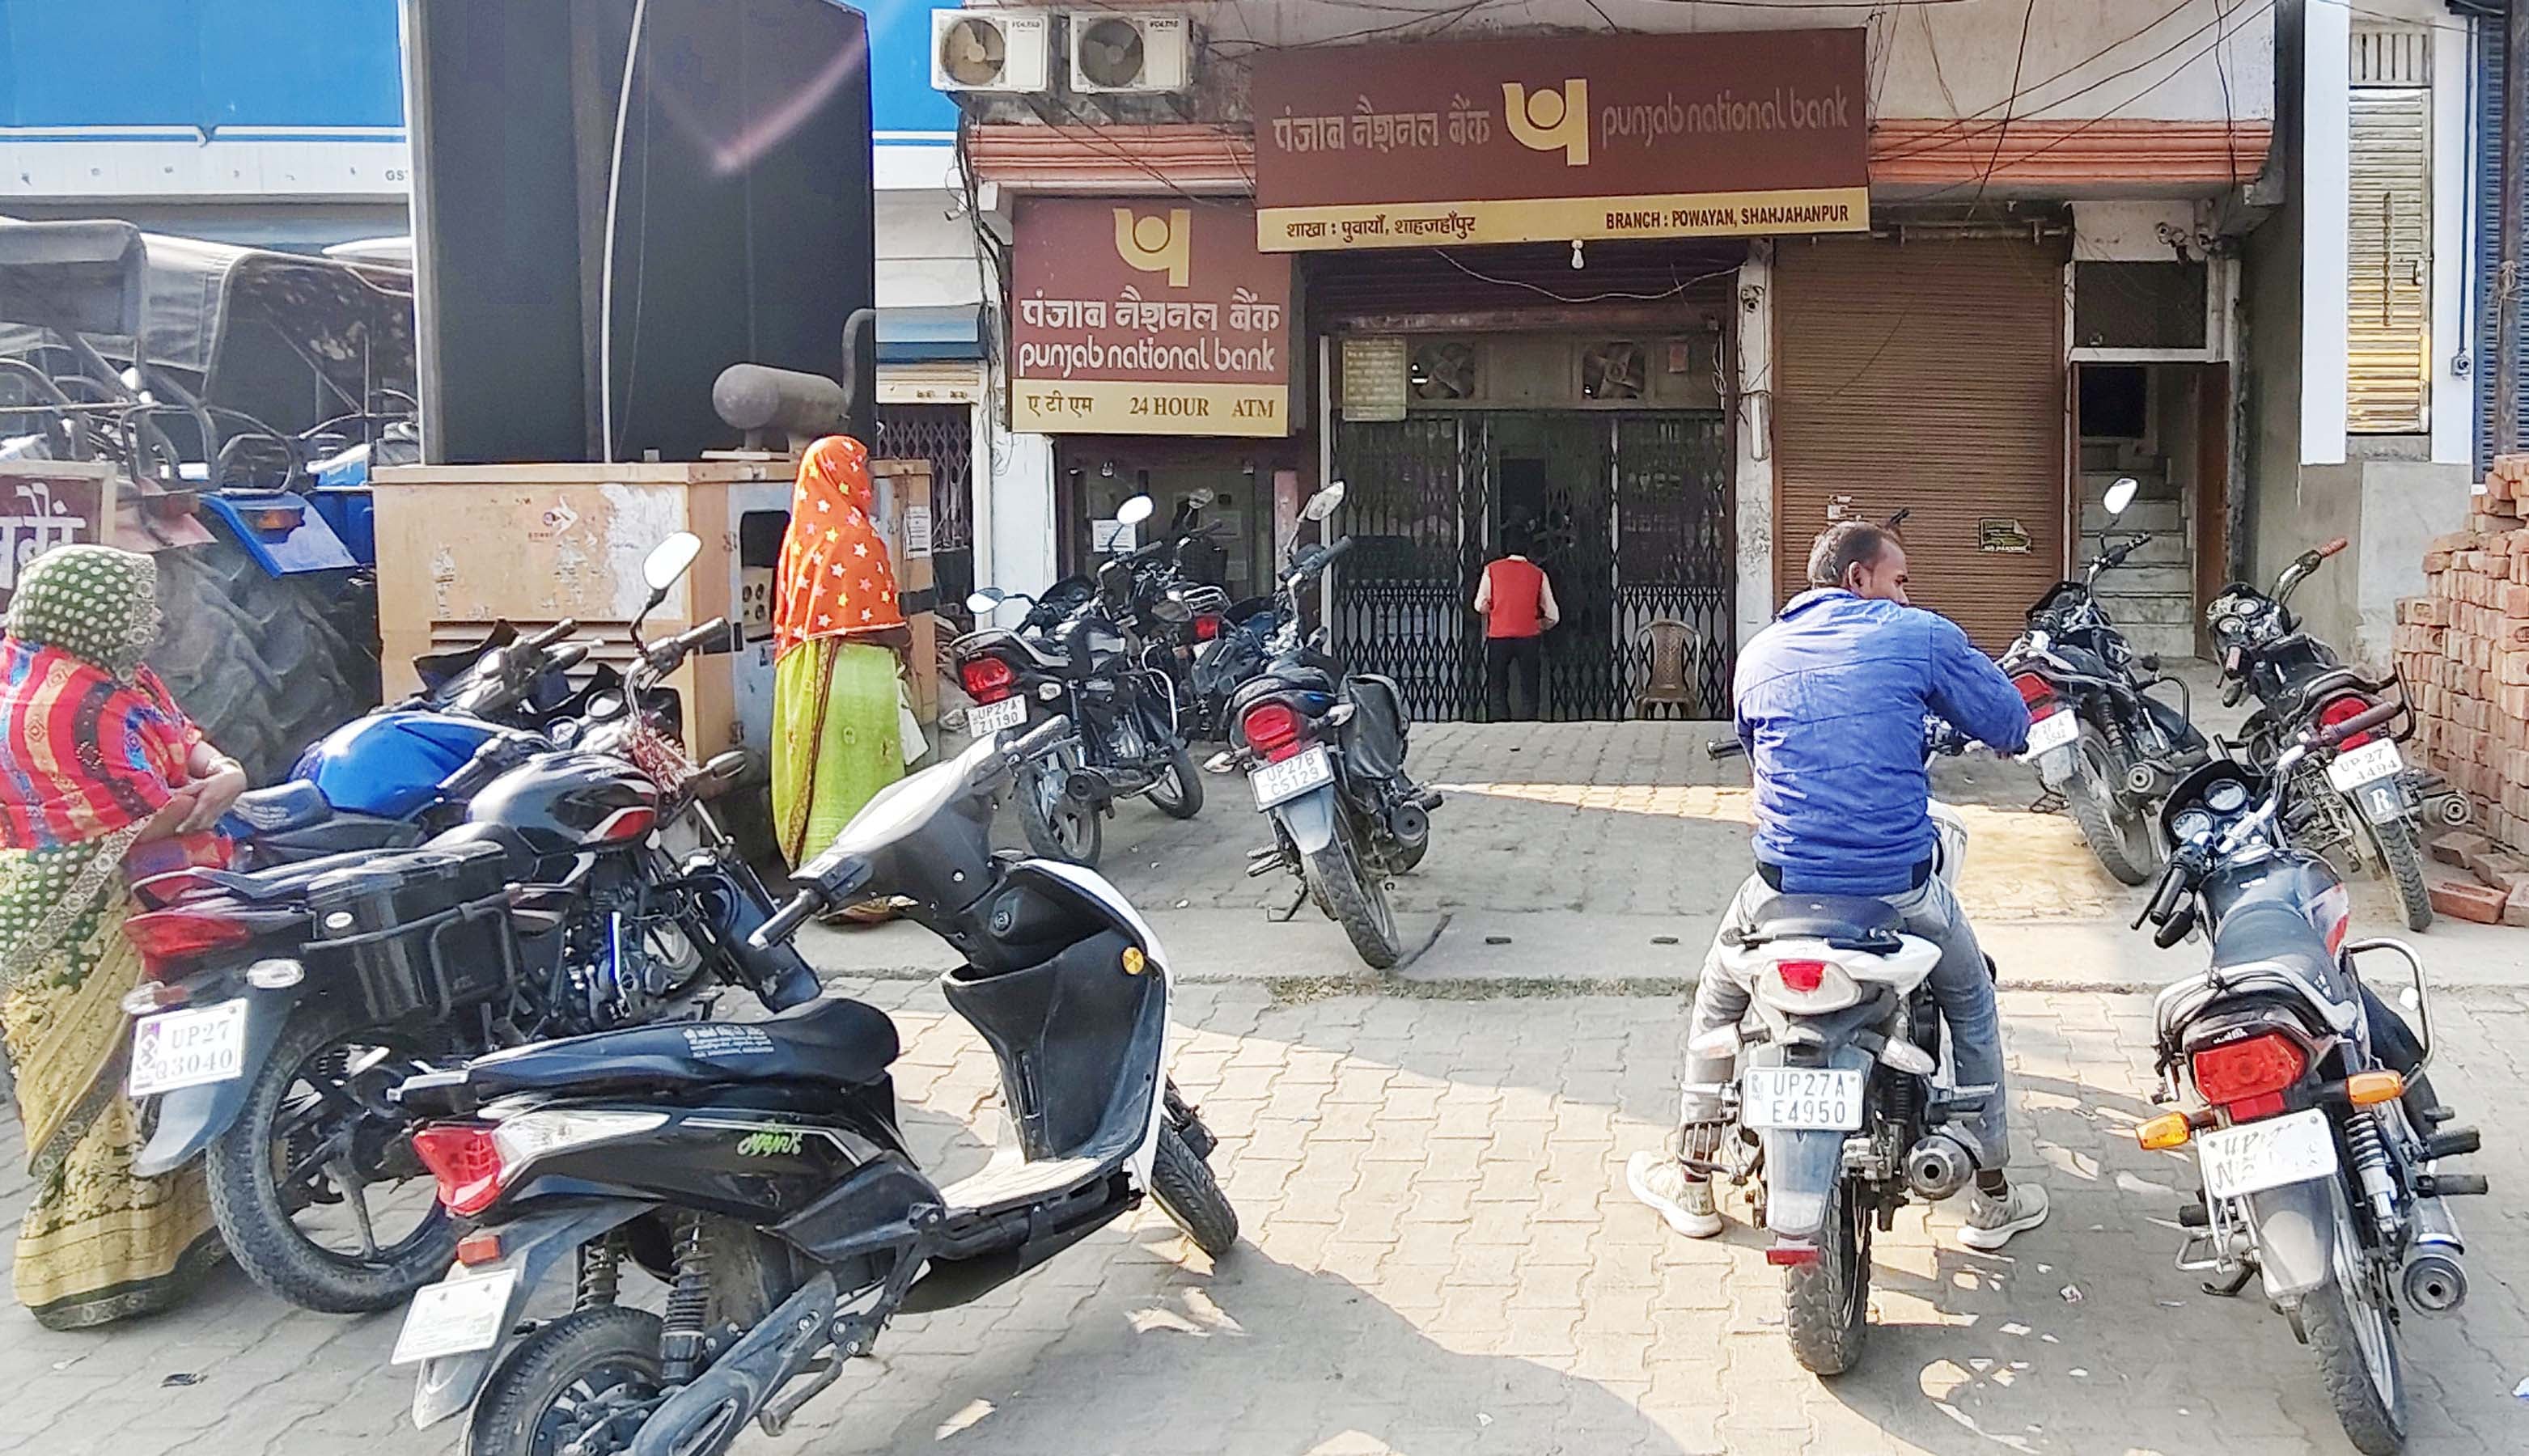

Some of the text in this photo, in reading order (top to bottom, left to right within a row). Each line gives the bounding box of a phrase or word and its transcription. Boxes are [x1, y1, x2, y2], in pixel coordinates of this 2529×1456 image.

[1273, 93, 1490, 154] पंजाब नैशनल बैंक
[1602, 84, 1849, 150] punjab national bank
[1286, 222, 1326, 237] शाखा
[1395, 210, 1476, 239] शाहजहाँपुर
[1606, 212, 1659, 230] BRANCH
[1672, 208, 1738, 228] POWAYAN,
[1741, 205, 1849, 225] SHAHJAHANPUR
[1020, 285, 1281, 333] पंजाब नैशनल बैंक
[1019, 334, 1275, 379] punjab national bank
[1026, 391, 1094, 418] ए टी एम
[1129, 397, 1275, 418] 24 HOUR ATM
[978, 699, 1017, 720] UP27A
[1266, 752, 1315, 782] UP27B
[171, 1019, 231, 1049] UP27
[1773, 1073, 1845, 1098] UP27A
[1773, 1100, 1845, 1124] E4950
